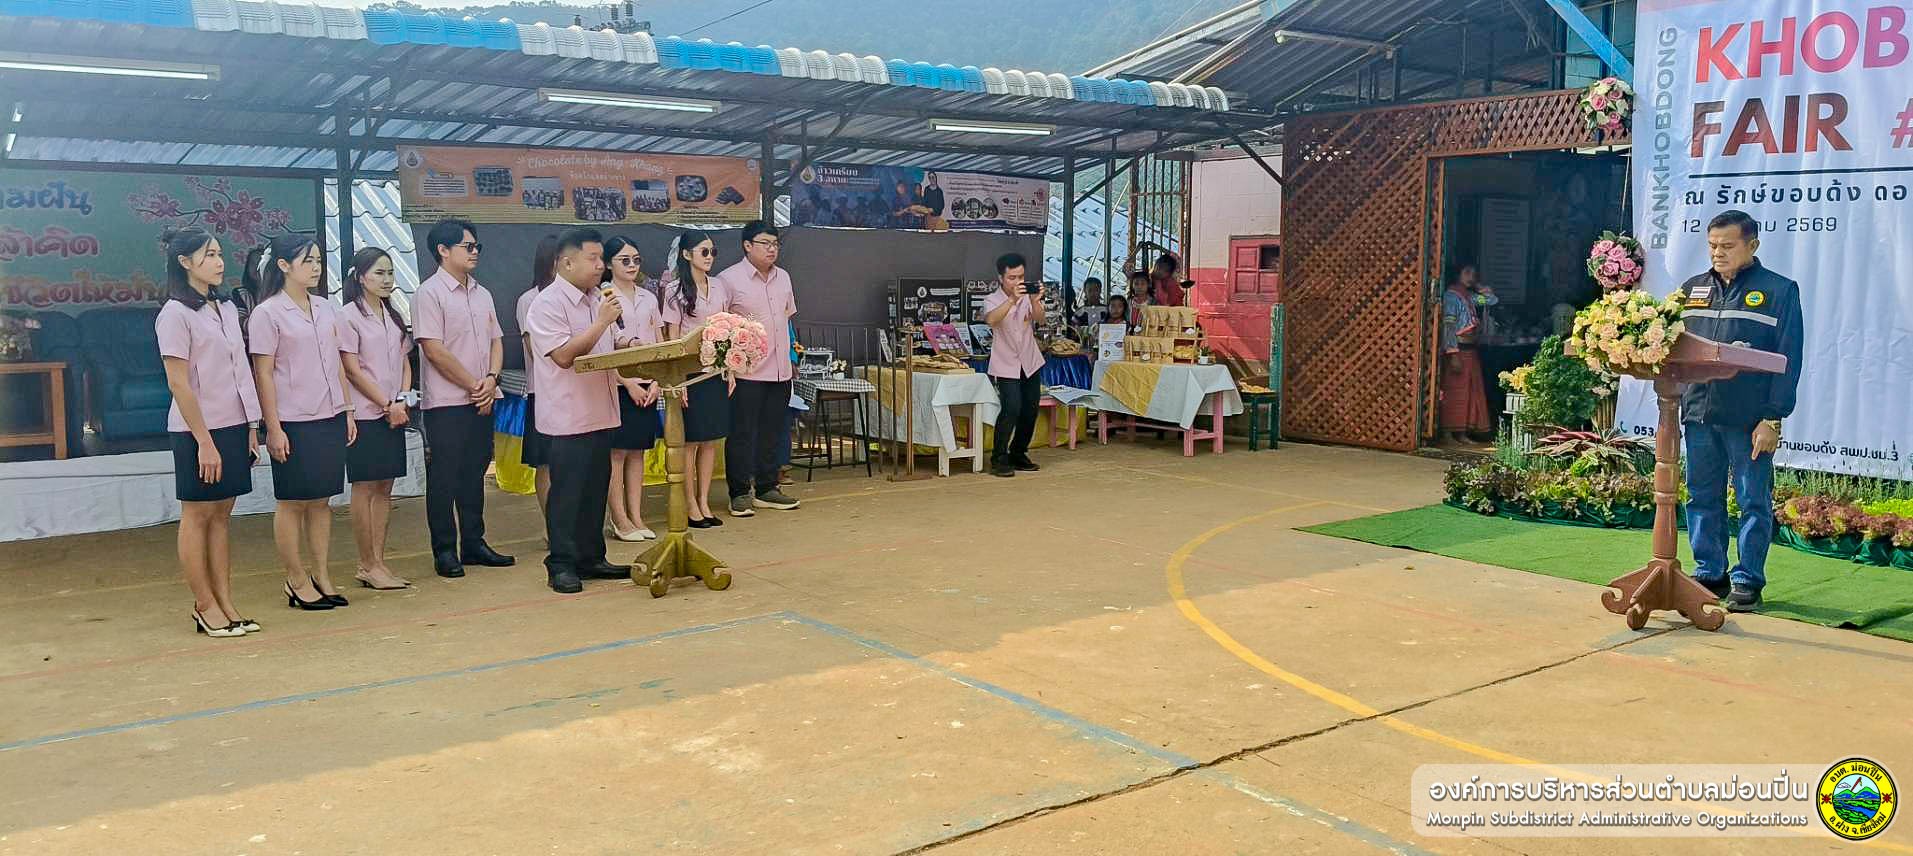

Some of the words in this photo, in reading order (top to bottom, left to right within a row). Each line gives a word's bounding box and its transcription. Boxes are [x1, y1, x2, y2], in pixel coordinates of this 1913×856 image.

[1696, 6, 1910, 84] KHOB
[1651, 27, 1678, 249] BANKHOBDONG
[1691, 92, 1854, 158] FAIR
[1685, 190, 1704, 206] ณ
[1716, 178, 1862, 206] รักษ์ขอบด้ง
[1682, 217, 1701, 233] 12
[1786, 216, 1838, 233] 2569
[1633, 425, 1657, 438] 053
